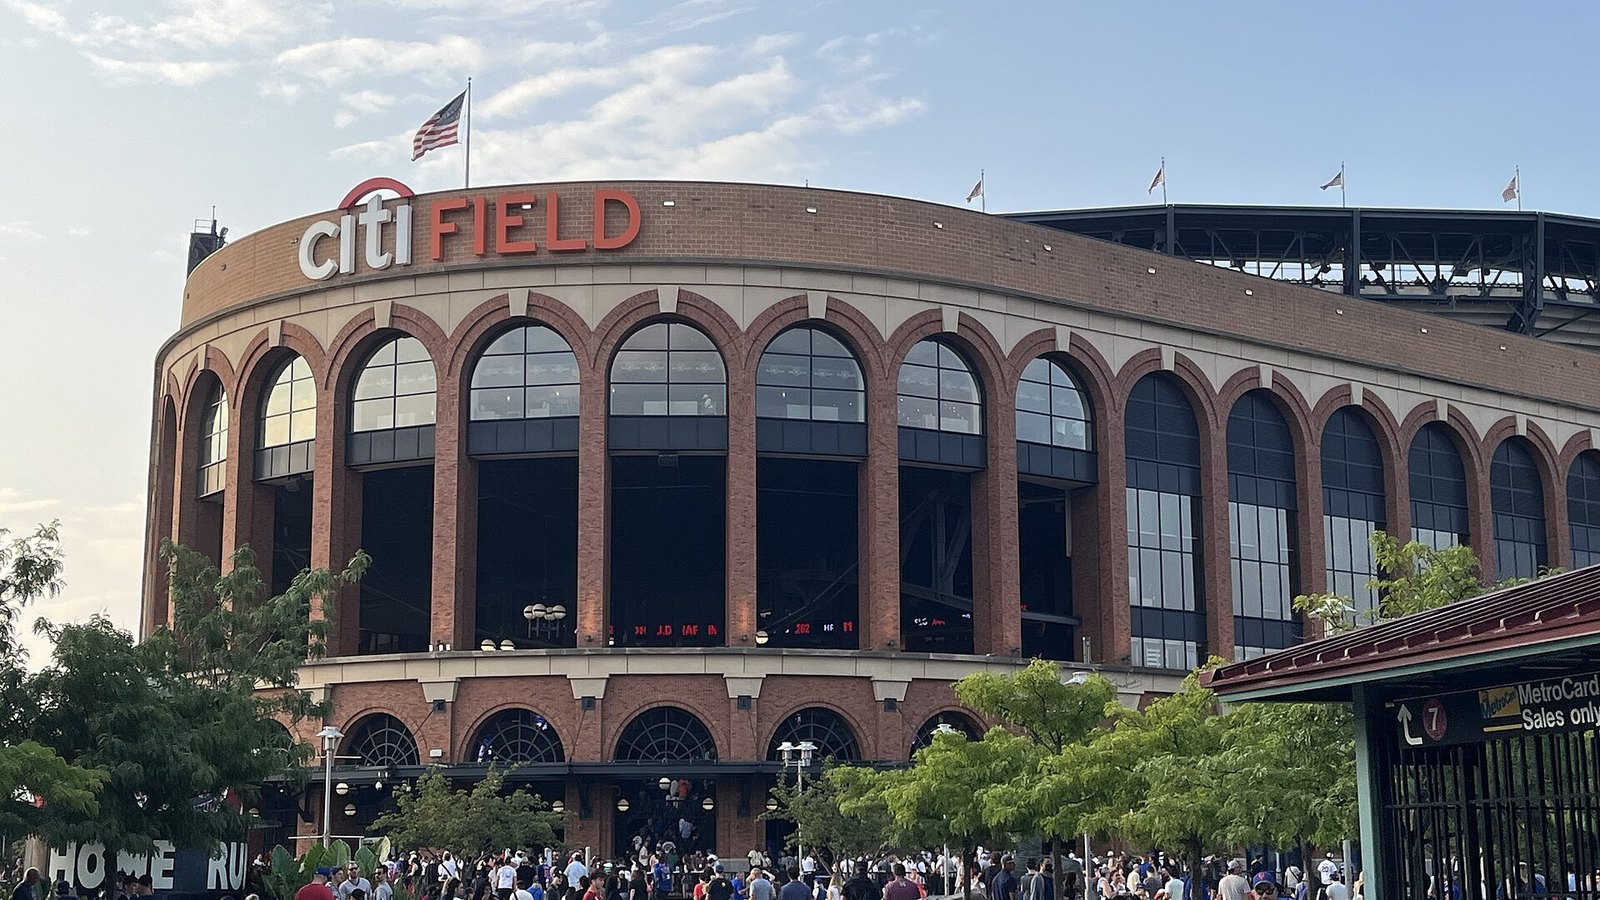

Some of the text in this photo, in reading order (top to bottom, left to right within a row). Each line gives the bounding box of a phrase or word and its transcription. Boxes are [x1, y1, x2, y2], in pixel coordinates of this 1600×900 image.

[298, 190, 641, 281] citi FIELD
[1518, 674, 1600, 705] MetroCard
[1429, 707, 1439, 731] 7
[1522, 701, 1600, 730] Sales only
[207, 841, 248, 890] RU
